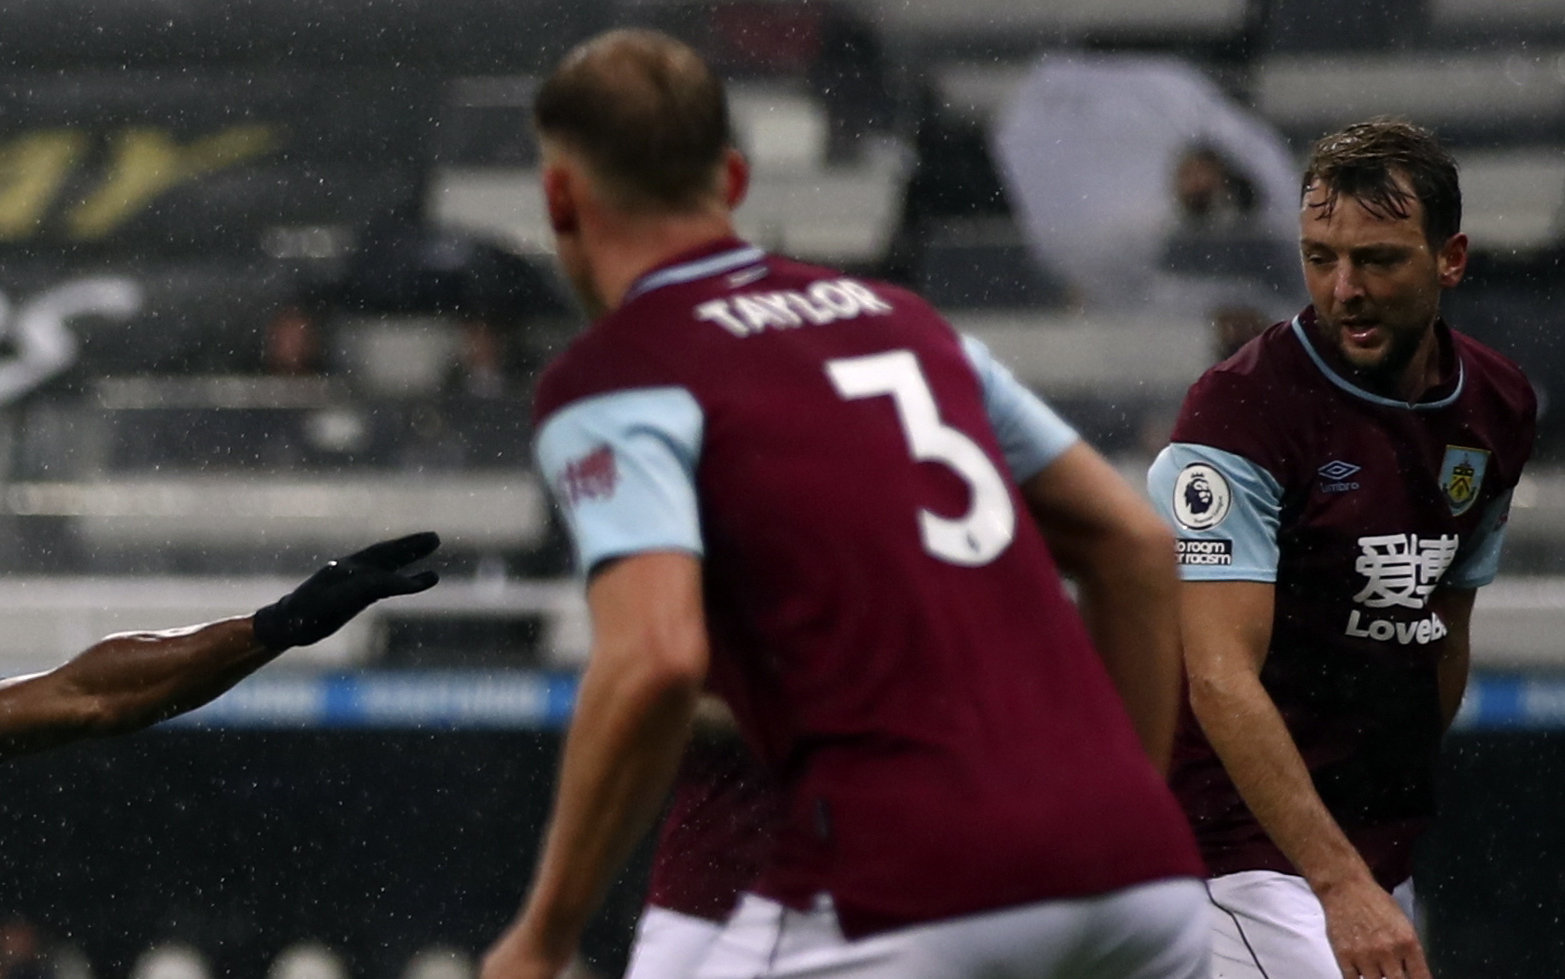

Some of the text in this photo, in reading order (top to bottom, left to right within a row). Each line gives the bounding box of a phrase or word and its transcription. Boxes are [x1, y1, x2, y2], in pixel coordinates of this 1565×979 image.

[695, 278, 894, 338] TAYLOR
[825, 349, 1015, 567] 3
[1187, 541, 1225, 553] room
